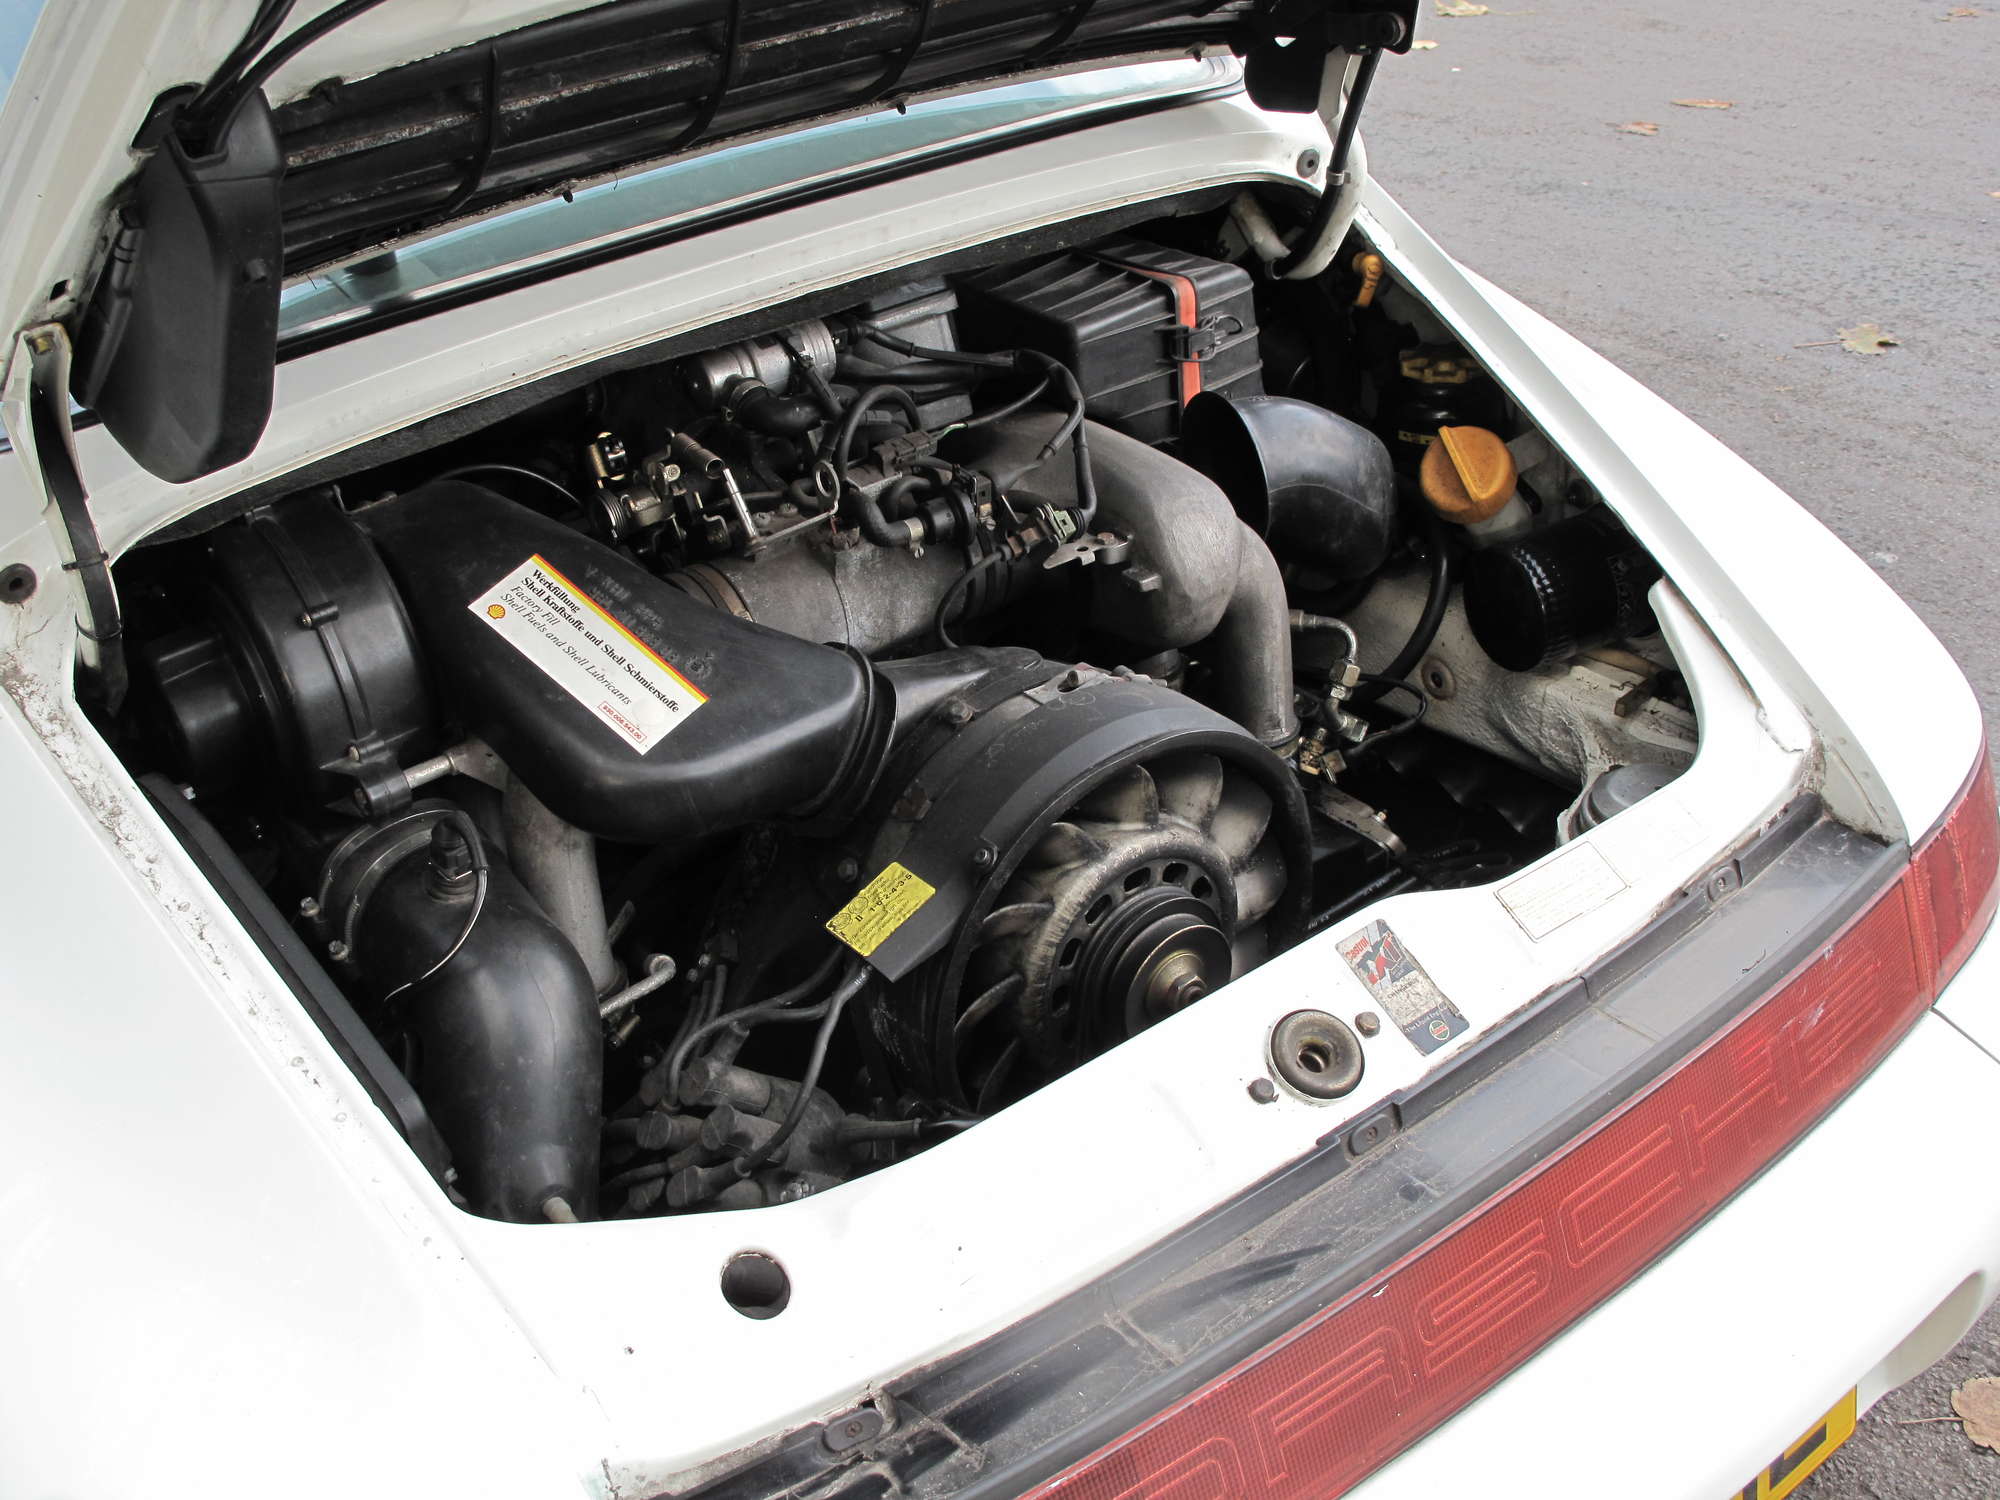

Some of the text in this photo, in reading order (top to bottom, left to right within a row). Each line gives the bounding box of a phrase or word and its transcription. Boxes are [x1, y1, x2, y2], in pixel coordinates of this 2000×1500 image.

[510, 586, 560, 626] Factory Fill
[533, 569, 580, 613] Werkfüllung
[501, 593, 631, 705] Shell Fuels and Shell Lubricants
[521, 577, 679, 713] Shell Kraftstoffe und Shell Schmierstoffe
[1344, 936, 1370, 961] Castrol
